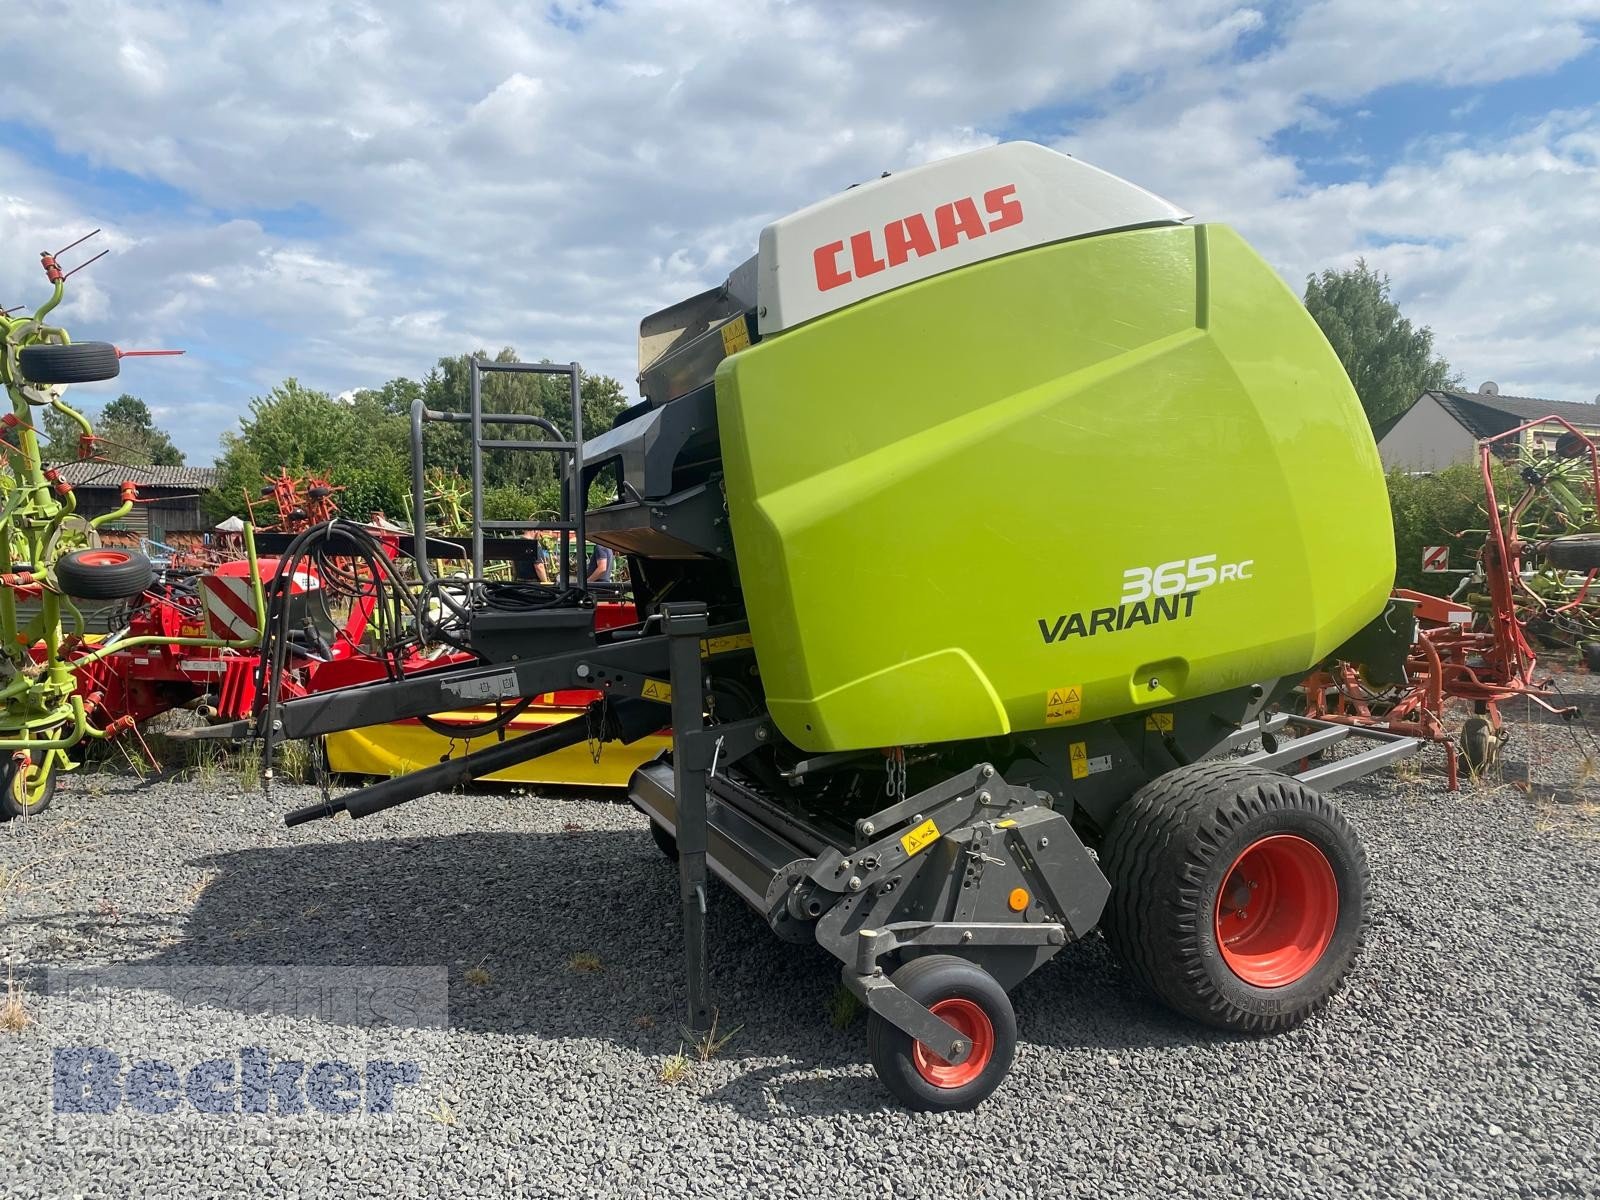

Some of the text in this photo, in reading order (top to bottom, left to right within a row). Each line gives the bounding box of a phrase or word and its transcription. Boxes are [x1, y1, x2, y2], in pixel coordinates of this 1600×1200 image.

[813, 184, 1024, 292] CLAAS
[1120, 553, 1254, 605] 365 RC
[1037, 589, 1201, 644] VARIANT
